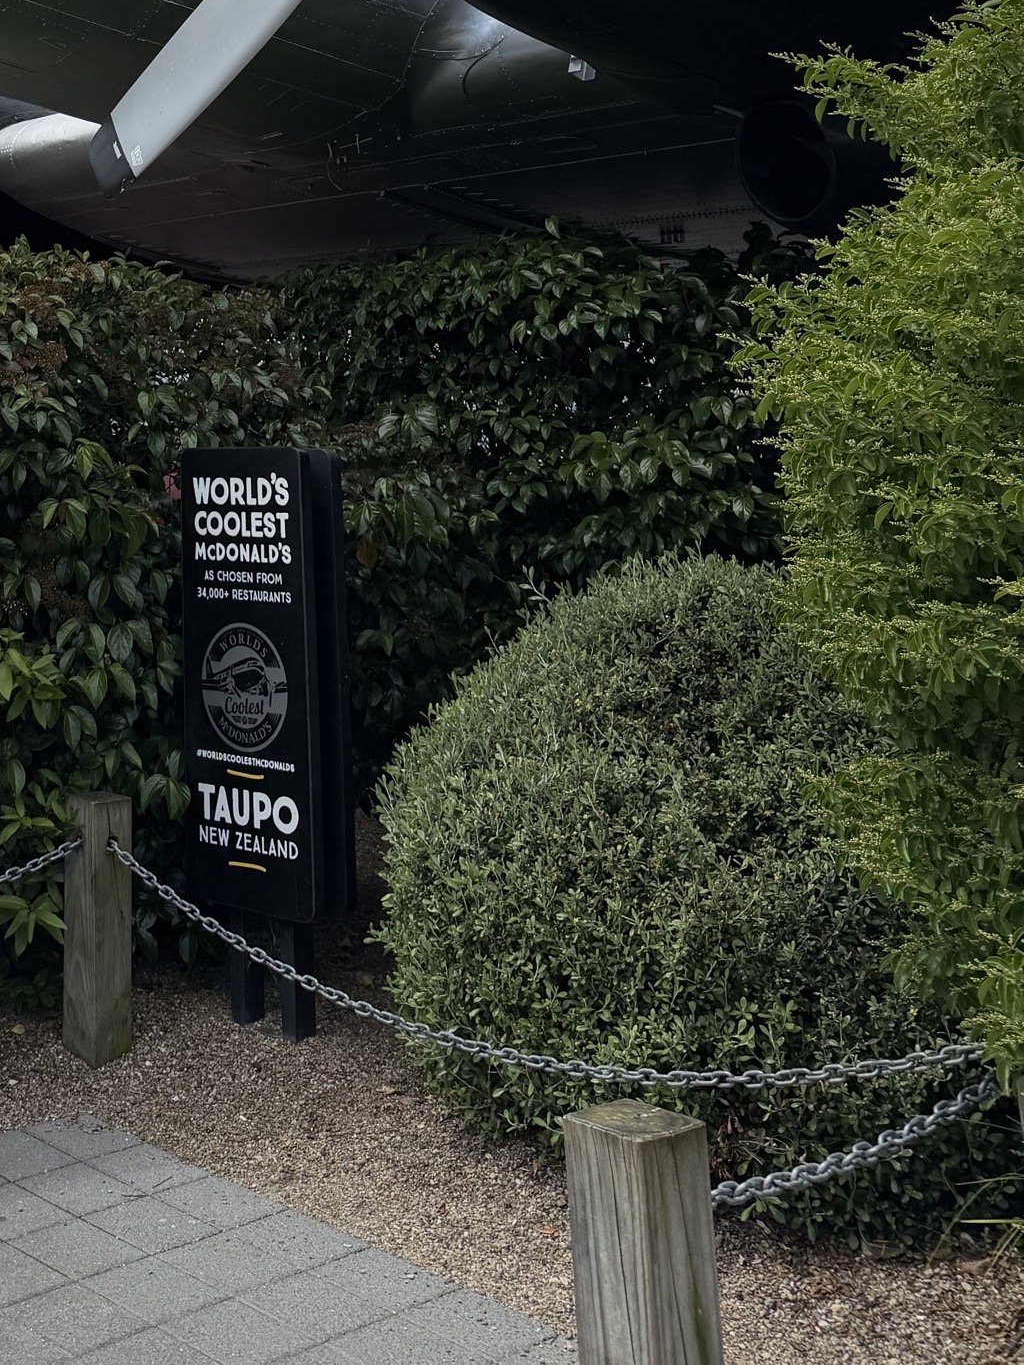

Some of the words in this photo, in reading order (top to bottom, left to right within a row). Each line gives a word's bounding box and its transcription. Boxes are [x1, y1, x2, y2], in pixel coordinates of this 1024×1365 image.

[192, 472, 290, 507] WORLD'S
[194, 510, 290, 539] COOLEST
[204, 569, 215, 581] AS
[217, 570, 254, 583] CHOSEN
[256, 572, 283, 585] FROM
[197, 586, 229, 600] 34,000+
[232, 589, 292, 604] RESTAURANTS
[225, 696, 265, 716] Coolest
[196, 748, 295, 773] #WORLDSCOOLESTMCDONALDS
[198, 782, 299, 835] TAUPO
[199, 824, 230, 848] NEW
[235, 831, 299, 861] ZEALAND
